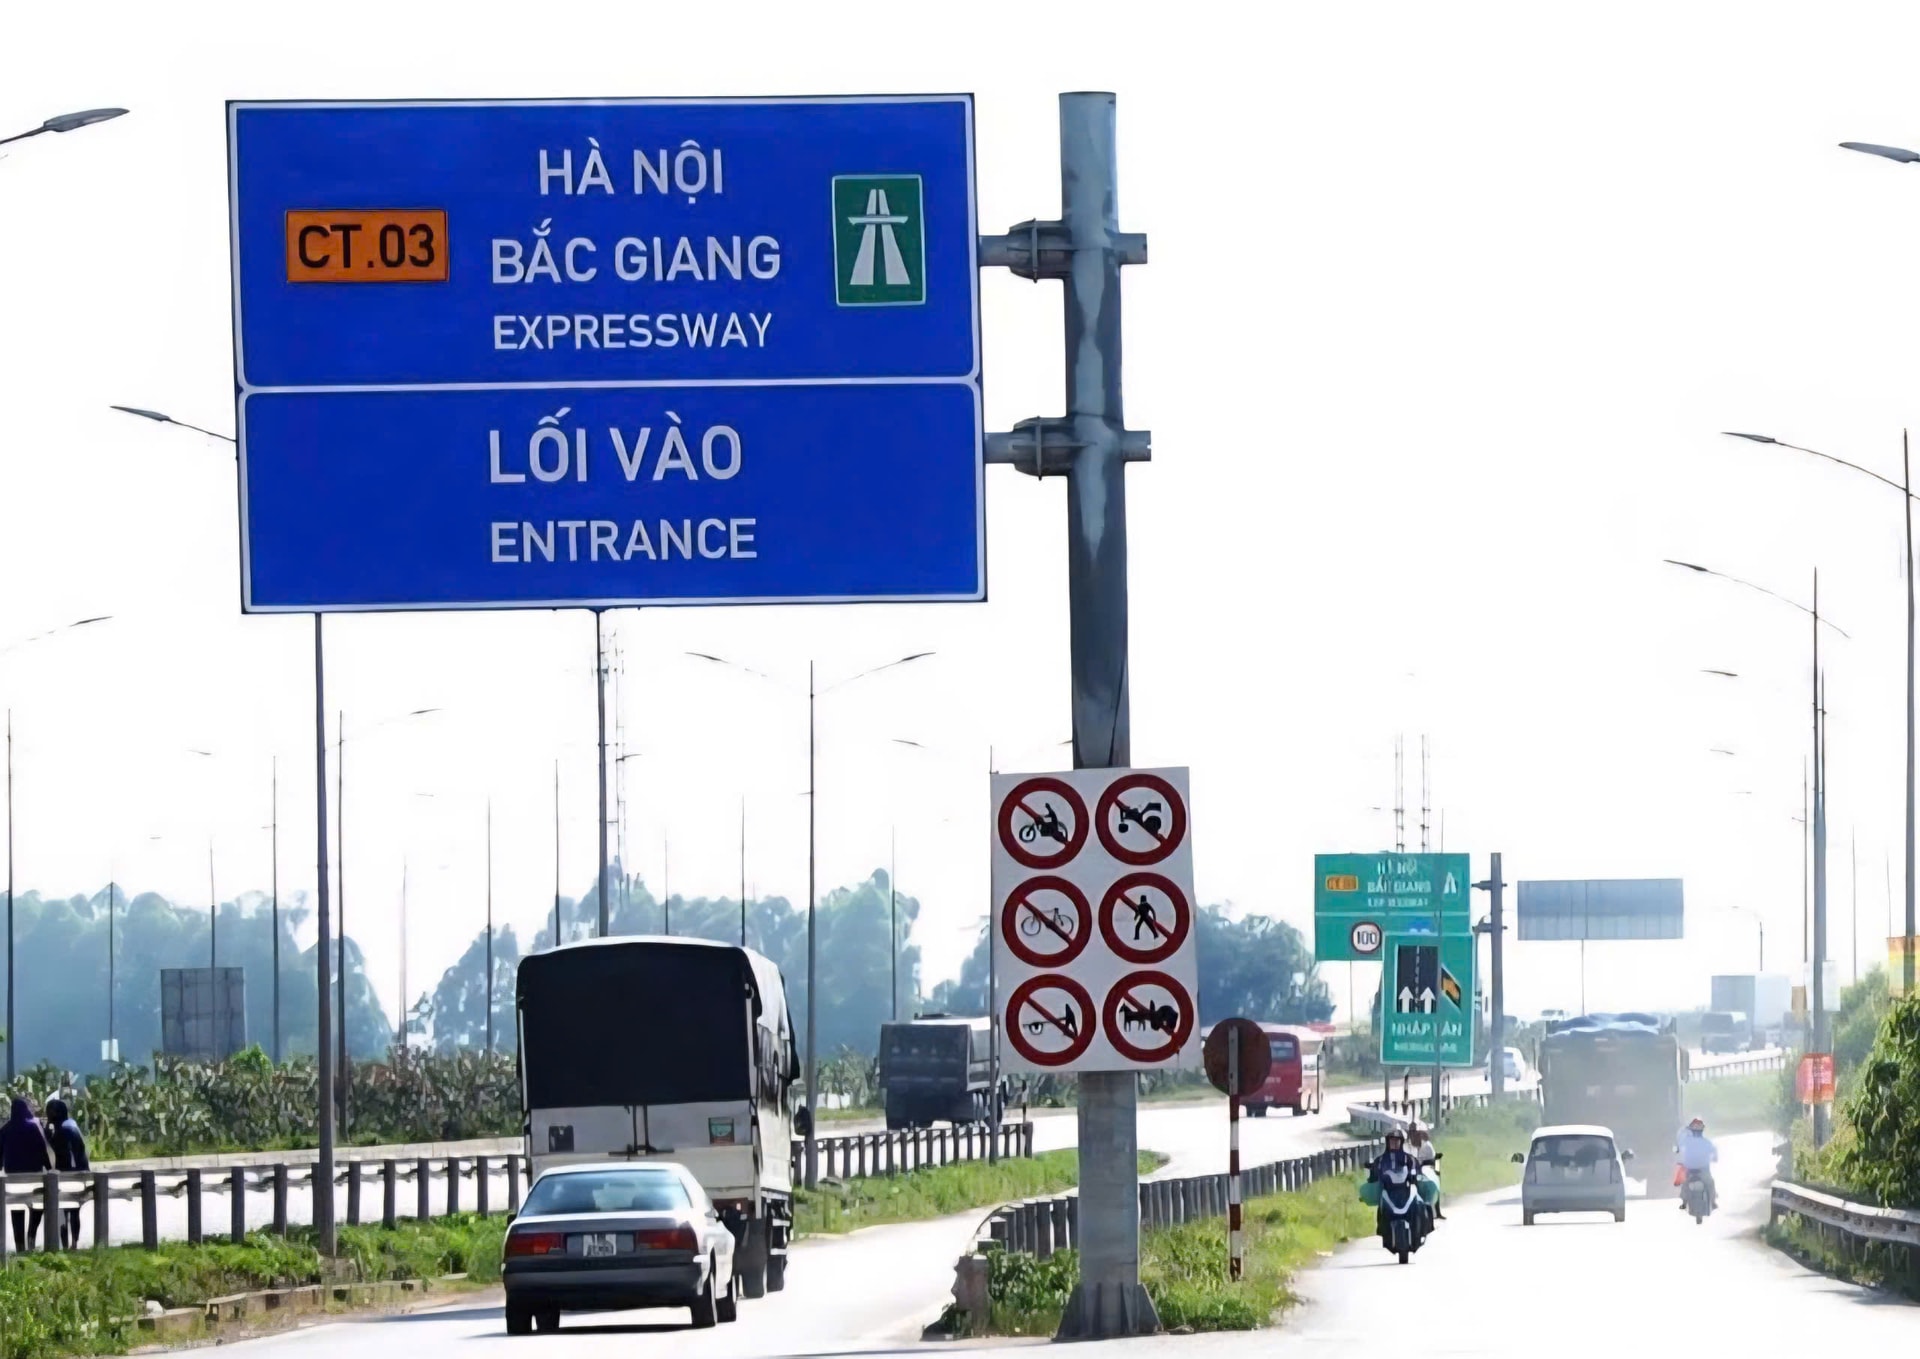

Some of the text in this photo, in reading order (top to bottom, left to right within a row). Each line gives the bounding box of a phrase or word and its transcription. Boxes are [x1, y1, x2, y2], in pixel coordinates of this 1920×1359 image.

[539, 136, 724, 205] HÀ NỘI
[297, 222, 437, 271] CT.03
[491, 217, 782, 285] BẮC GIANG
[492, 311, 773, 351] EXPRESSWAY
[488, 406, 743, 484] LỐI VÀO
[490, 517, 758, 564] ENTRANCE
[1356, 930, 1378, 945] 100
